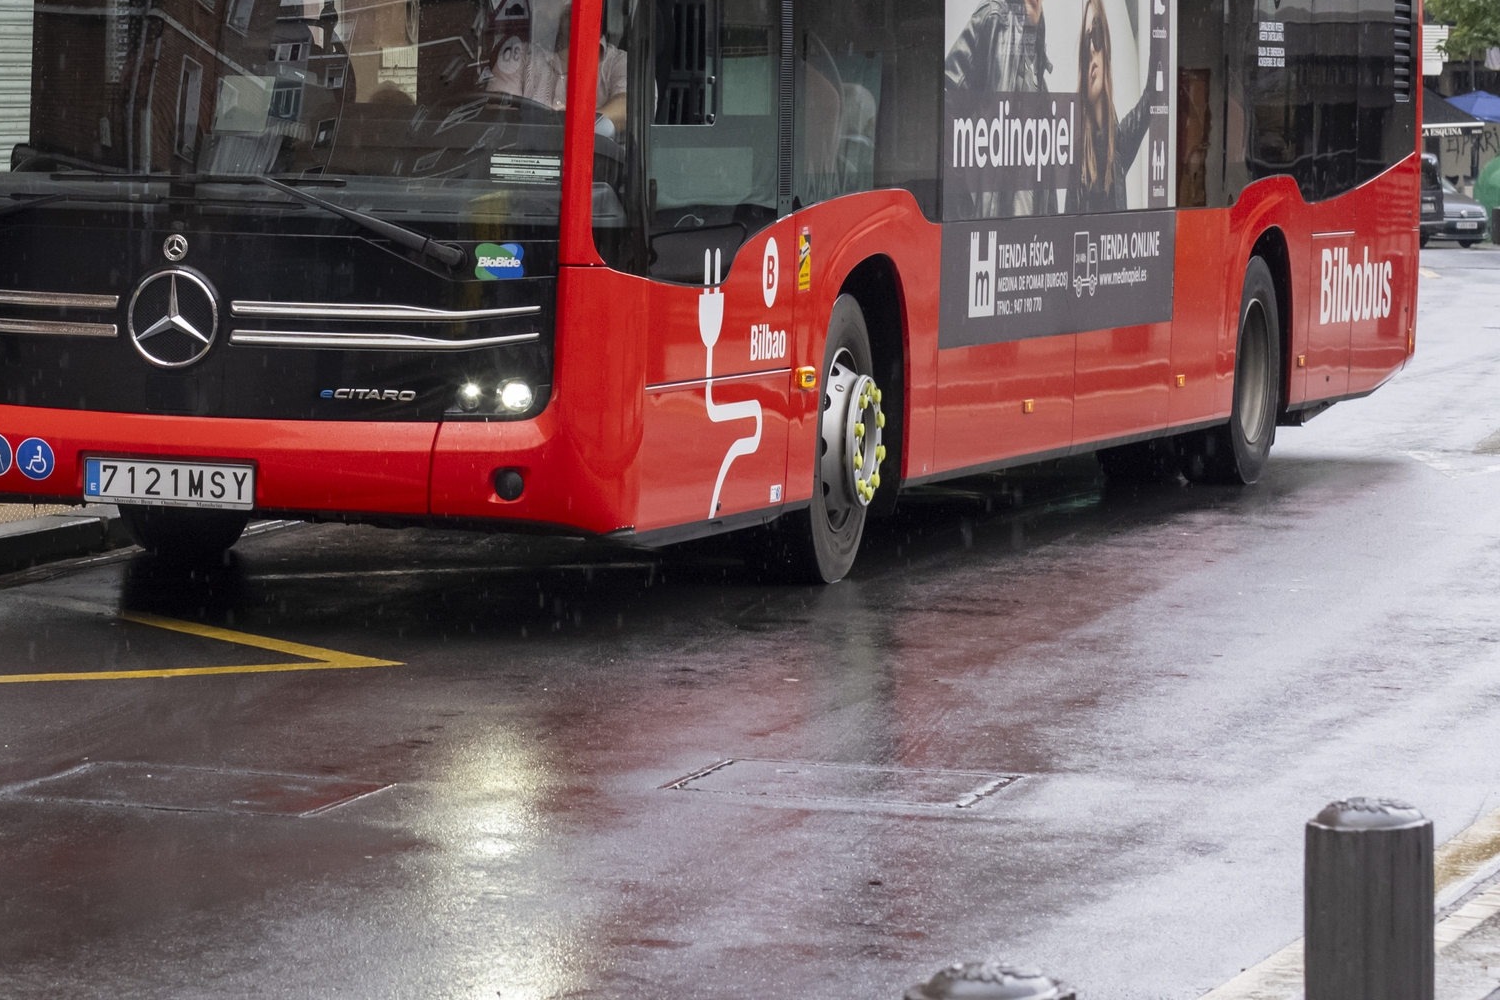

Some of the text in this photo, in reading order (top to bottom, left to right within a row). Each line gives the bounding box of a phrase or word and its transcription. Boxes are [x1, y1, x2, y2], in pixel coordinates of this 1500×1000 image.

[953, 100, 1074, 181] medinapiel
[1430, 128, 1462, 137] ESQUINA
[477, 256, 521, 267] BioBide
[998, 235, 1054, 269] TIENDA FÍSICA
[1100, 231, 1160, 261] TIENDA ONLINE
[766, 255, 776, 290] B
[997, 276, 1018, 292] MEDINA
[1019, 276, 1026, 290] DE
[1026, 274, 1044, 289] POMAR
[1320, 246, 1392, 325] Bilbobus
[1013, 299, 1023, 314] 947
[750, 324, 786, 361] Bilbao
[90, 464, 247, 500] E 7121MSY
